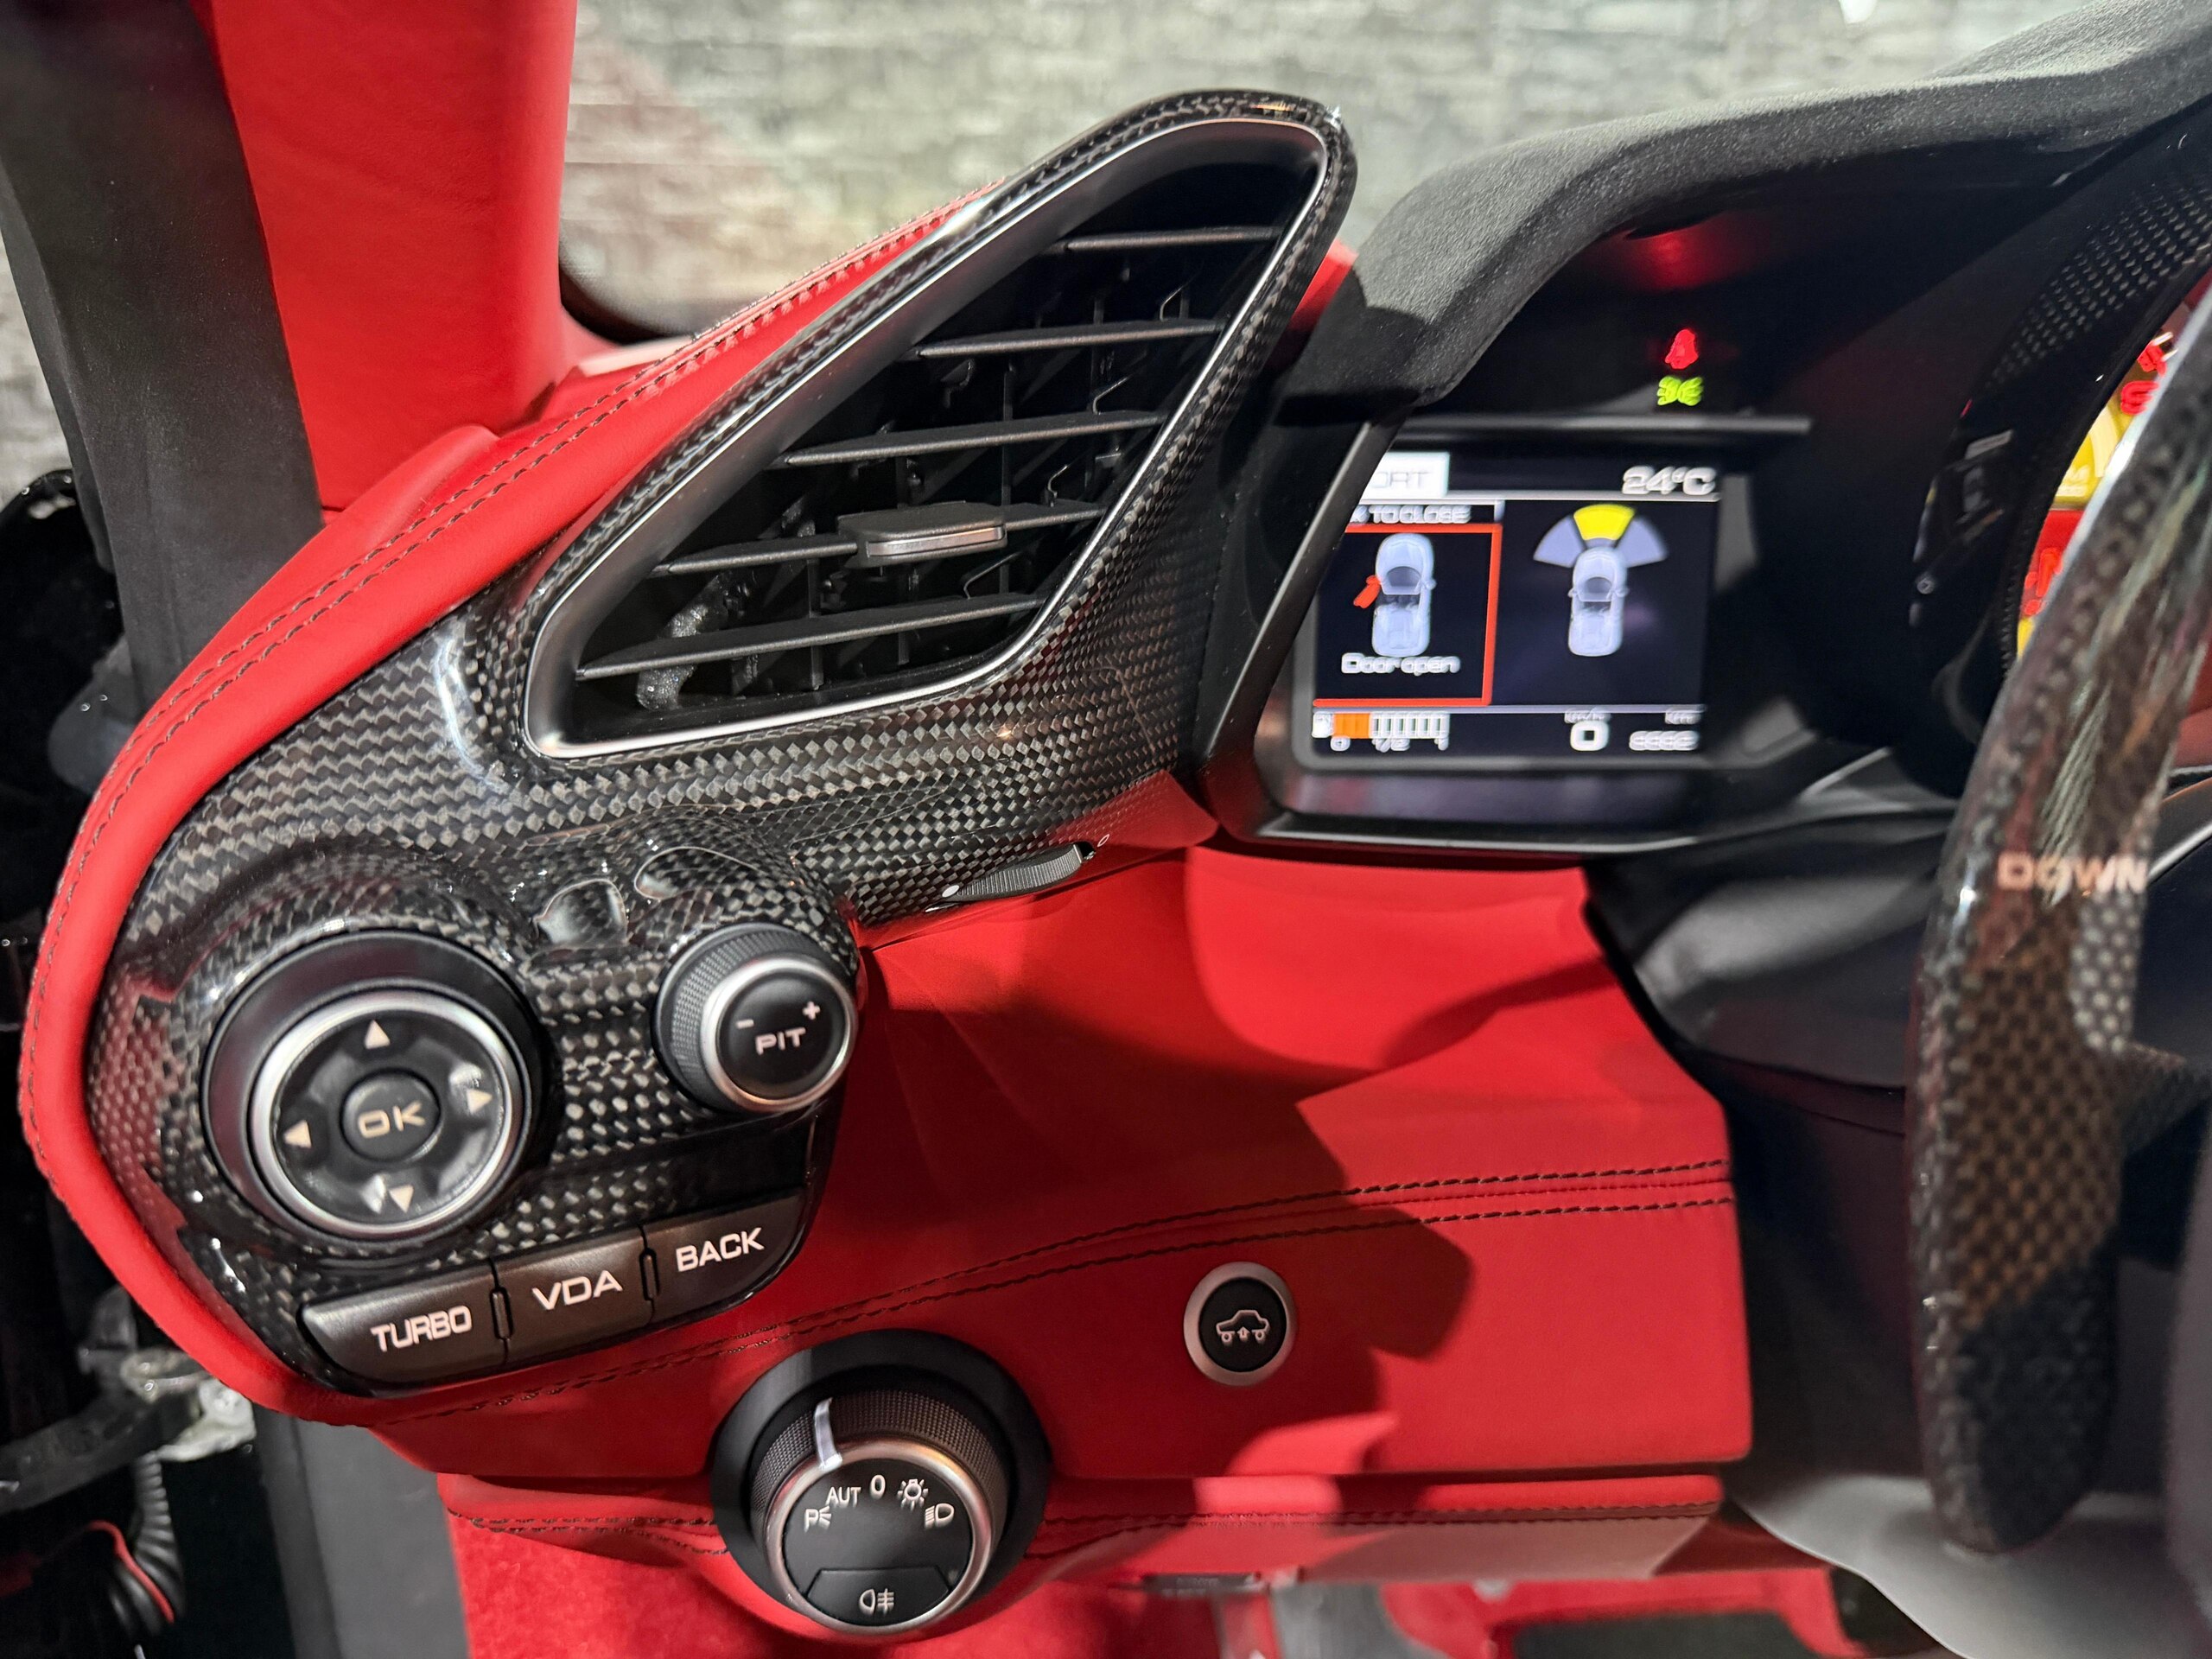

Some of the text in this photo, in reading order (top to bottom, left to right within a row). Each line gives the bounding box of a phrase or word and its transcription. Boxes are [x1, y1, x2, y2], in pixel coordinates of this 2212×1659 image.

[1341, 652, 1460, 677] Door open
[1997, 852, 2148, 893] DOWN
[754, 1027, 806, 1056] PIT
[357, 1103, 426, 1137] OK
[675, 1226, 766, 1273] BACK
[531, 1269, 624, 1311] VDA
[370, 1305, 473, 1352] TURBO
[825, 1486, 861, 1509] AUT
